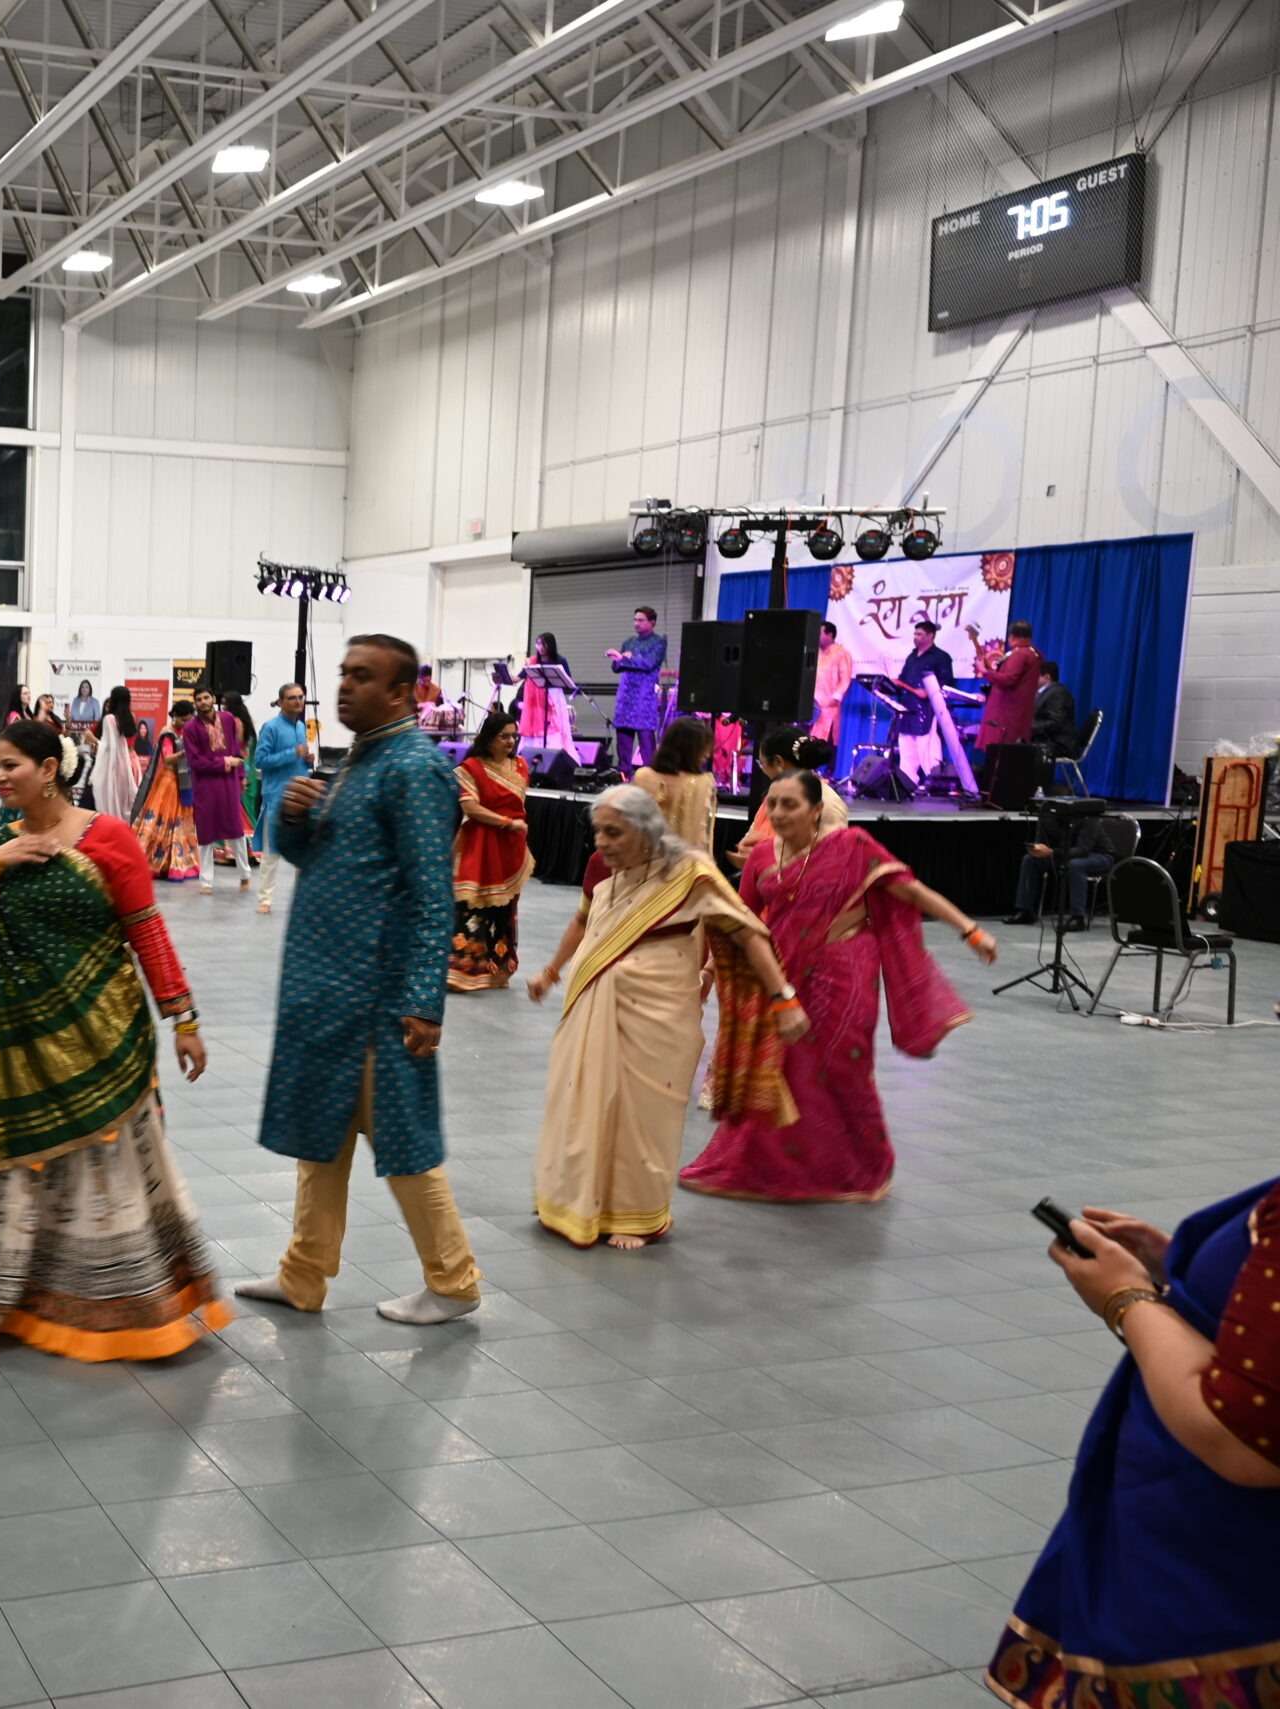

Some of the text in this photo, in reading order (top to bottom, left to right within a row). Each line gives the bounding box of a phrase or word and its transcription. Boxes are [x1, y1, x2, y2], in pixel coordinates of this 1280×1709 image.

[1076, 163, 1128, 191] GUEST
[937, 211, 981, 236] HOME
[1007, 190, 1069, 240] 7:05
[1007, 243, 1043, 261] PERIOD
